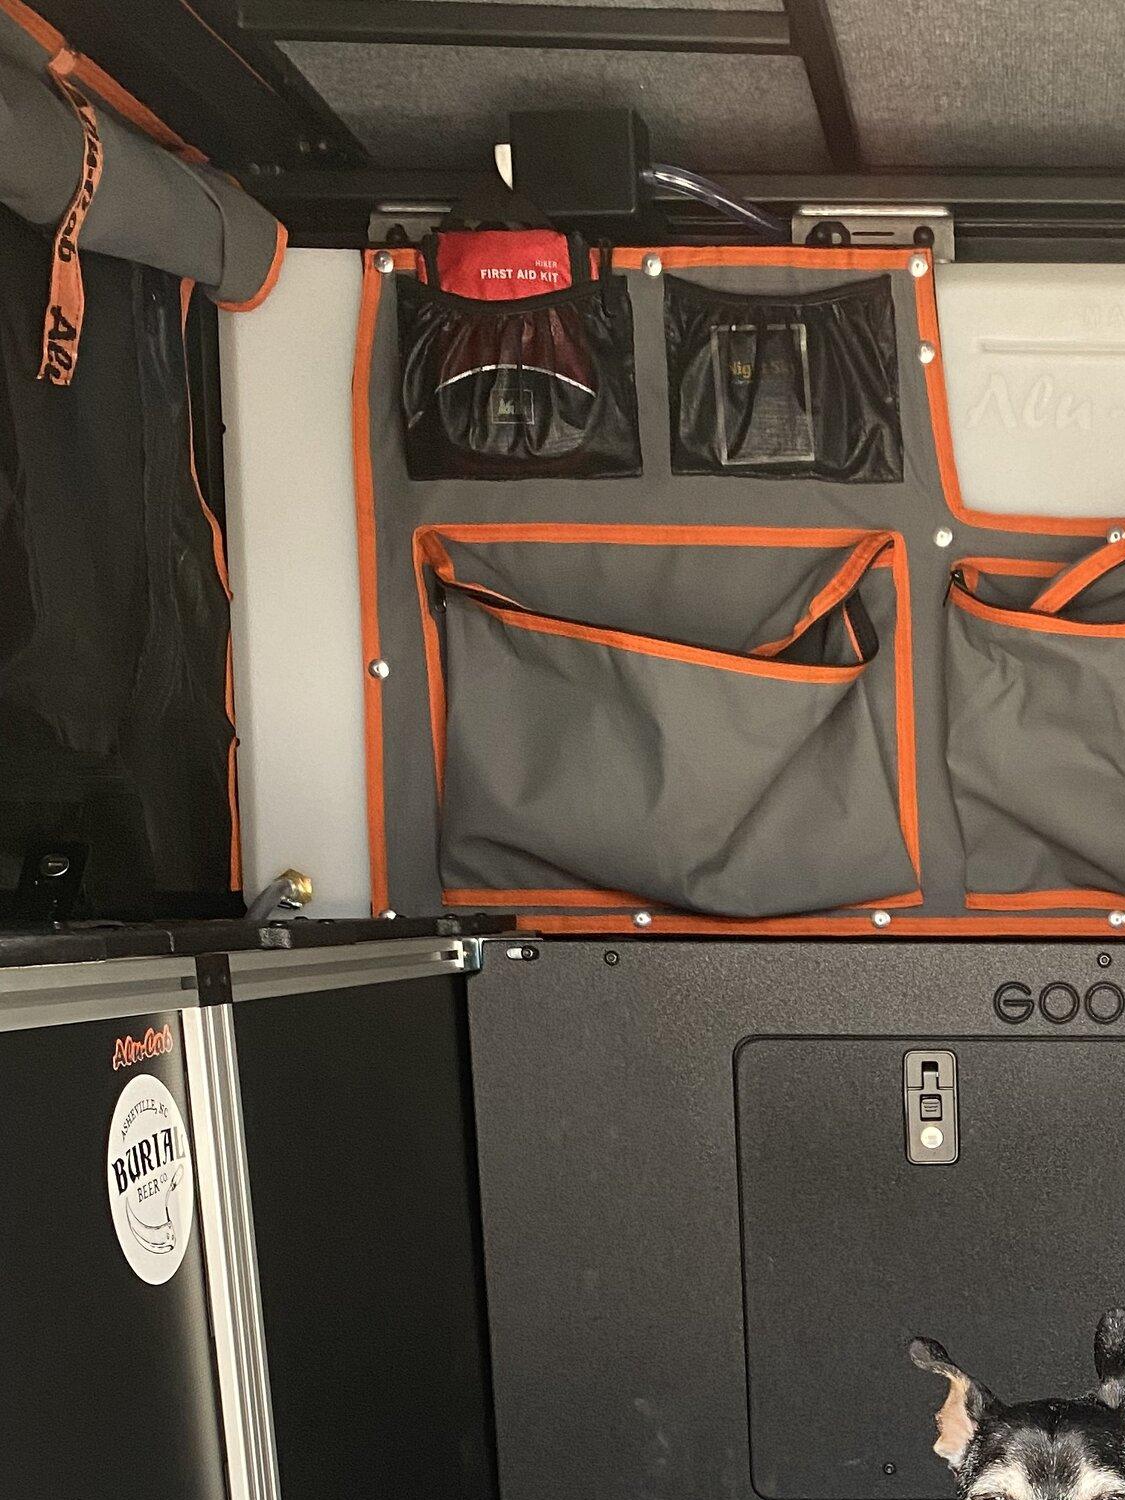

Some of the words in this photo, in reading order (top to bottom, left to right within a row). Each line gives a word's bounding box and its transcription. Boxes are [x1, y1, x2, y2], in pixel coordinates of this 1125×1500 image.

[535, 259, 558, 269] HIKER
[480, 268, 513, 280] FIRST
[516, 268, 537, 280] AID
[540, 270, 559, 283] KIT
[158, 1102, 169, 1119] NC
[111, 1126, 187, 1196] BURIAL
[136, 1177, 161, 1203] BEER
